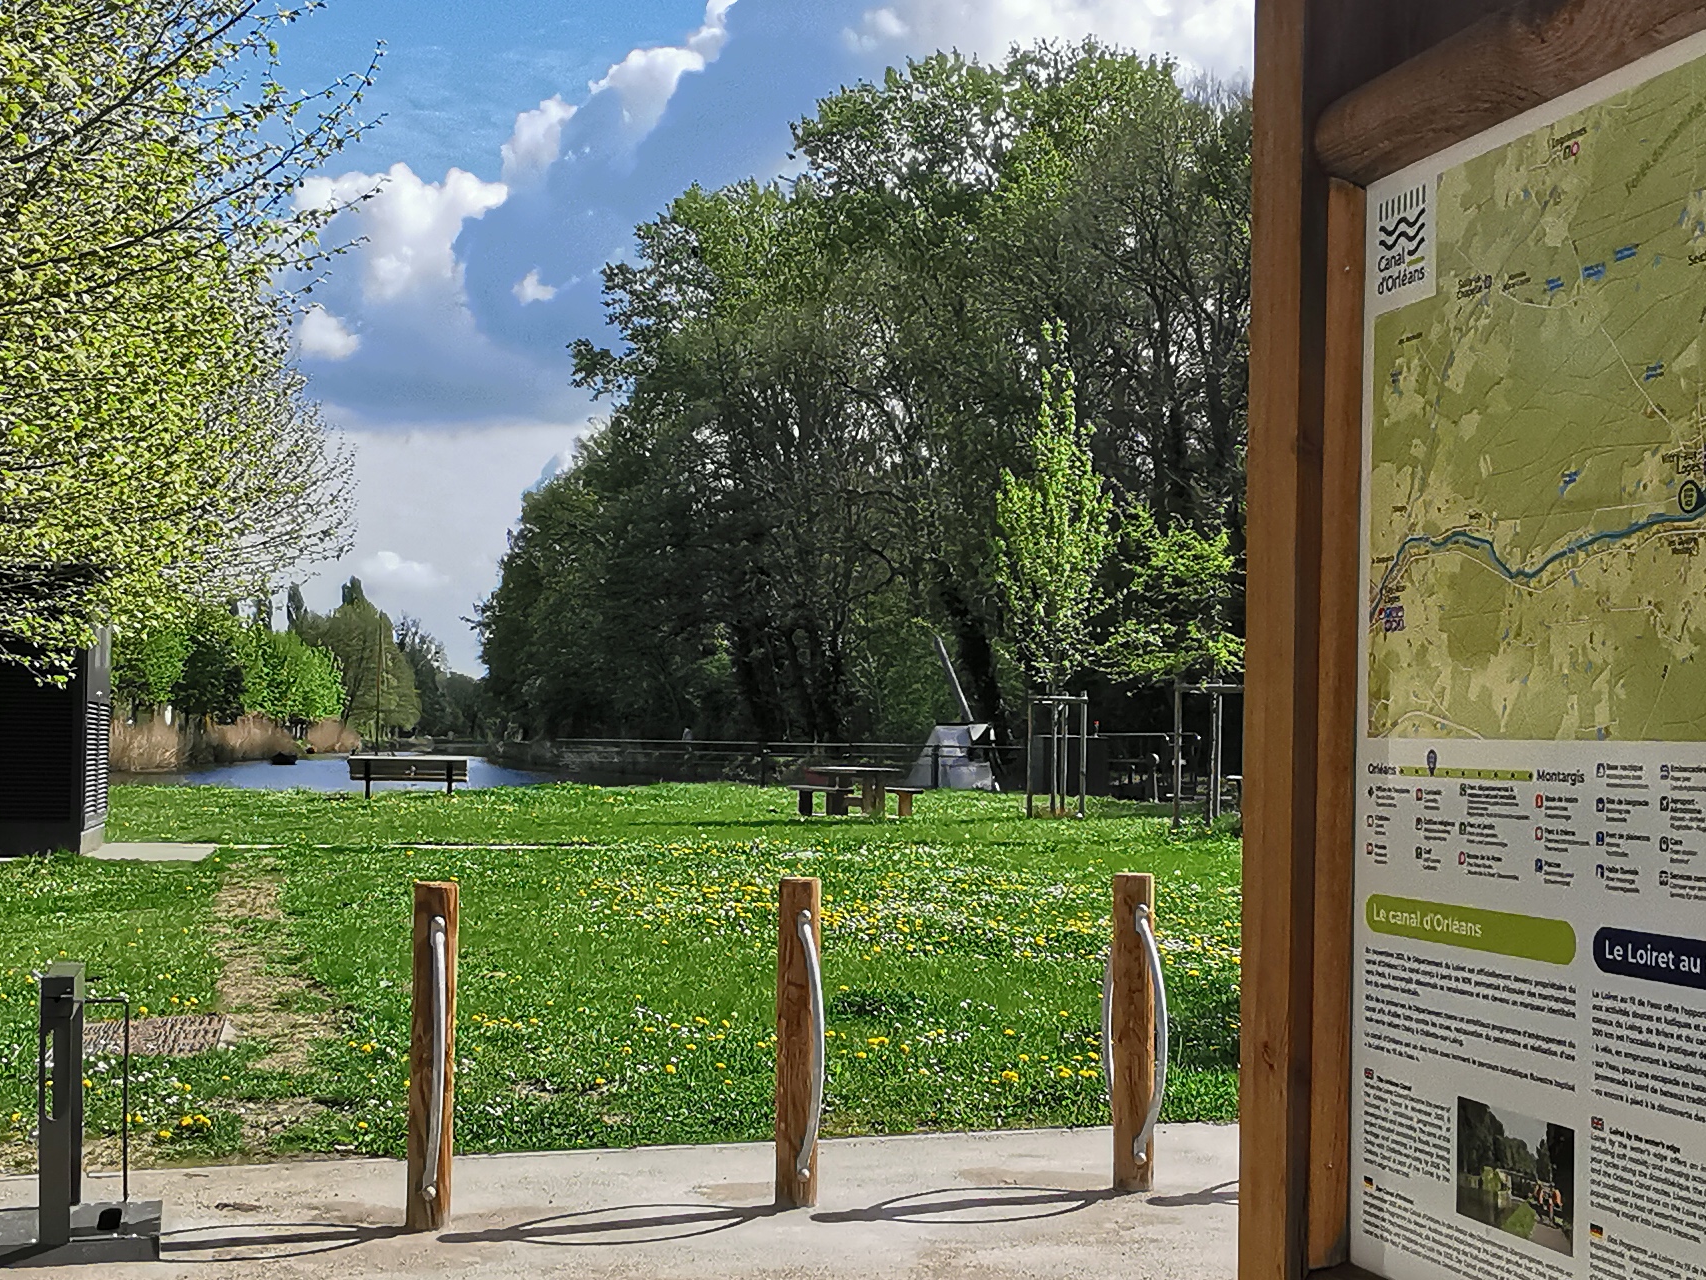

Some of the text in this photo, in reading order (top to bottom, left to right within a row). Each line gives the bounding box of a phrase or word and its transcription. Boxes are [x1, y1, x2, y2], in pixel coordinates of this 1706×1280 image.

[1377, 246, 1425, 295] Canal d'Orléans
[1366, 763, 1585, 786] Orléans Montargis
[1373, 902, 1482, 937] Le canal d'Orléans
[1605, 939, 1623, 960] Le
[1627, 943, 1675, 969] Loiret
[1679, 955, 1700, 973] au
